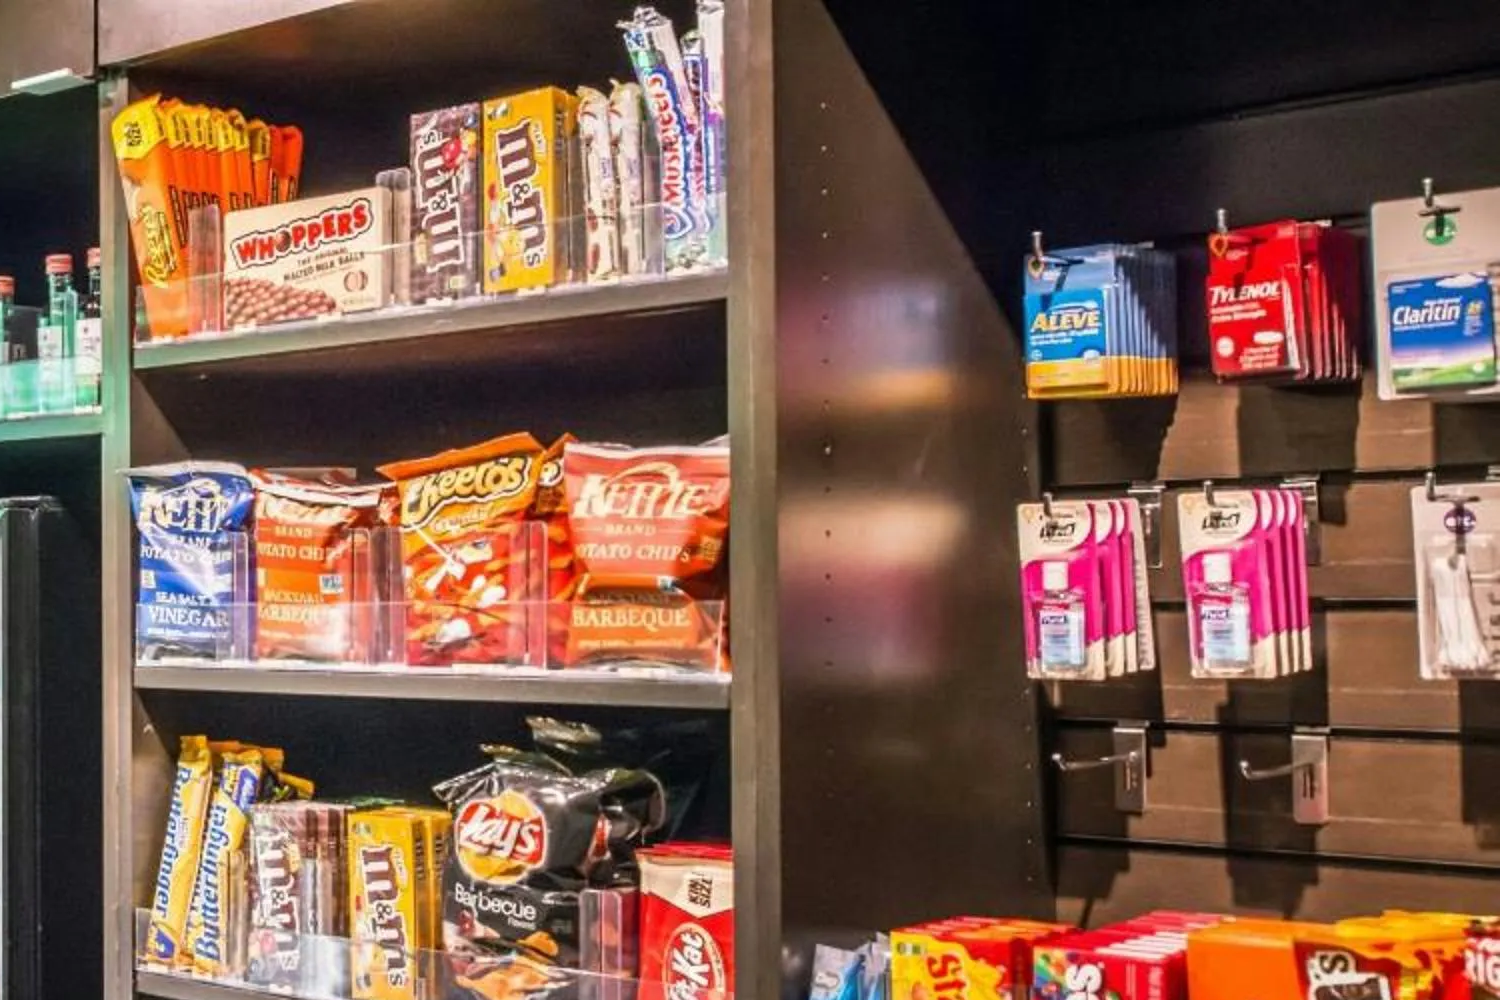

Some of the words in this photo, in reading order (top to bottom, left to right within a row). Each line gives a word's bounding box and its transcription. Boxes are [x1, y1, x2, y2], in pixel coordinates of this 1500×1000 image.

[235, 202, 370, 266] WHOPPERS
[315, 260, 336, 273] MILK
[1210, 280, 1283, 306] TYLENOL
[1031, 311, 1102, 332] ALEVE
[1393, 302, 1461, 326] Claritin
[402, 454, 529, 529] Cheetos
[572, 462, 714, 519] KETTLE
[606, 523, 657, 537] BRAND
[575, 543, 632, 561] OTATO
[636, 544, 692, 563] CHIPS
[148, 605, 230, 627] VINEGAR
[573, 606, 694, 632] BARBEQUE
[194, 803, 229, 961] Butterfinger
[454, 882, 538, 921] Barbecue
